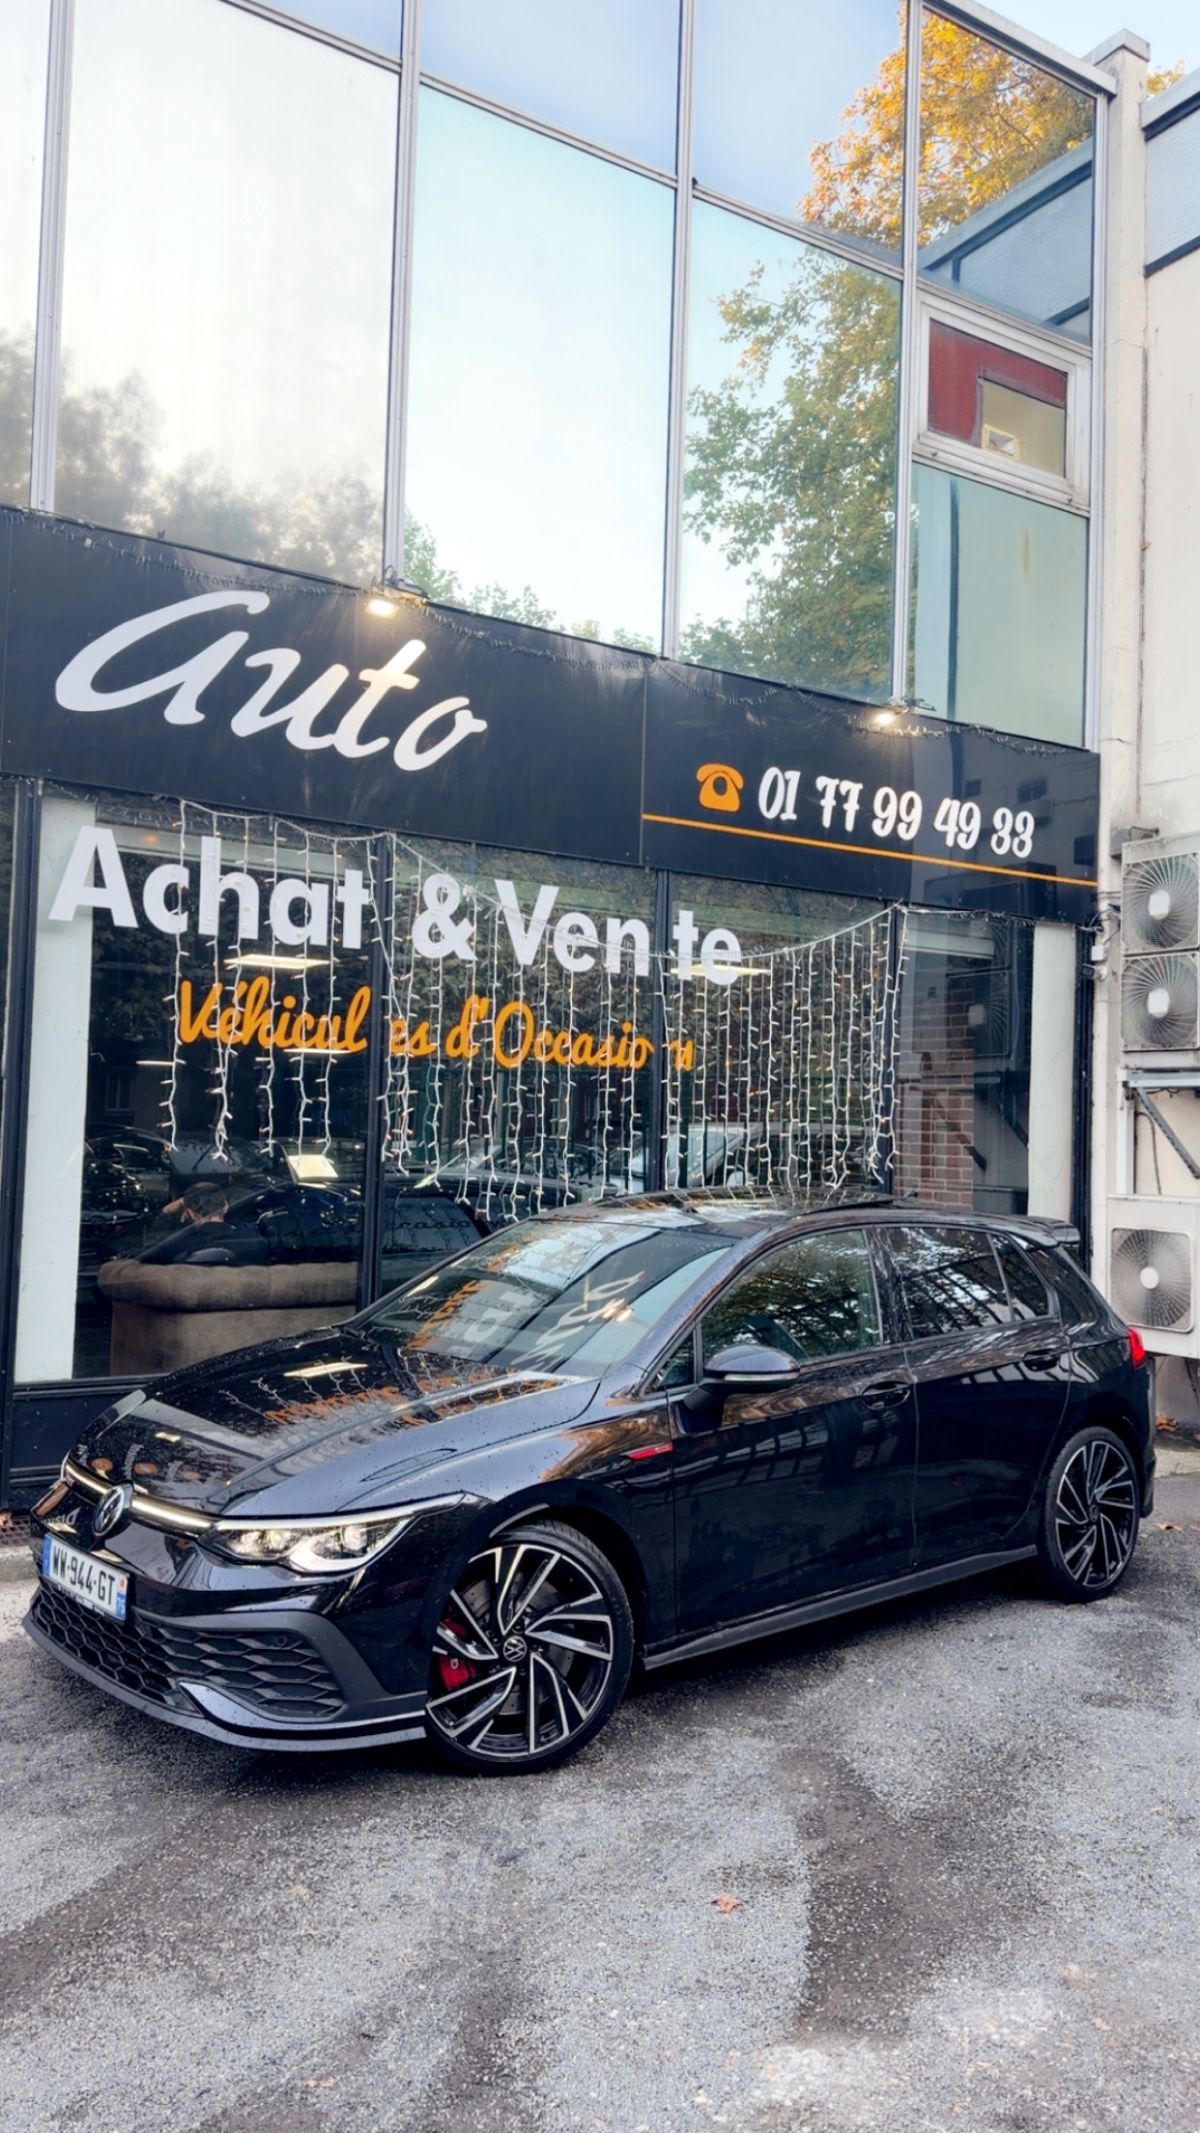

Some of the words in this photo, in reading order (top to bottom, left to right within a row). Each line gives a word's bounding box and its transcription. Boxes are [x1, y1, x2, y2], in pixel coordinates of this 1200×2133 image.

[758, 766, 801, 821] 01
[815, 775, 863, 832] 77
[872, 786, 923, 841] 99
[933, 797, 981, 850] 49
[990, 807, 1035, 859] 33
[48, 825, 371, 949] Achat
[411, 873, 478, 961] &
